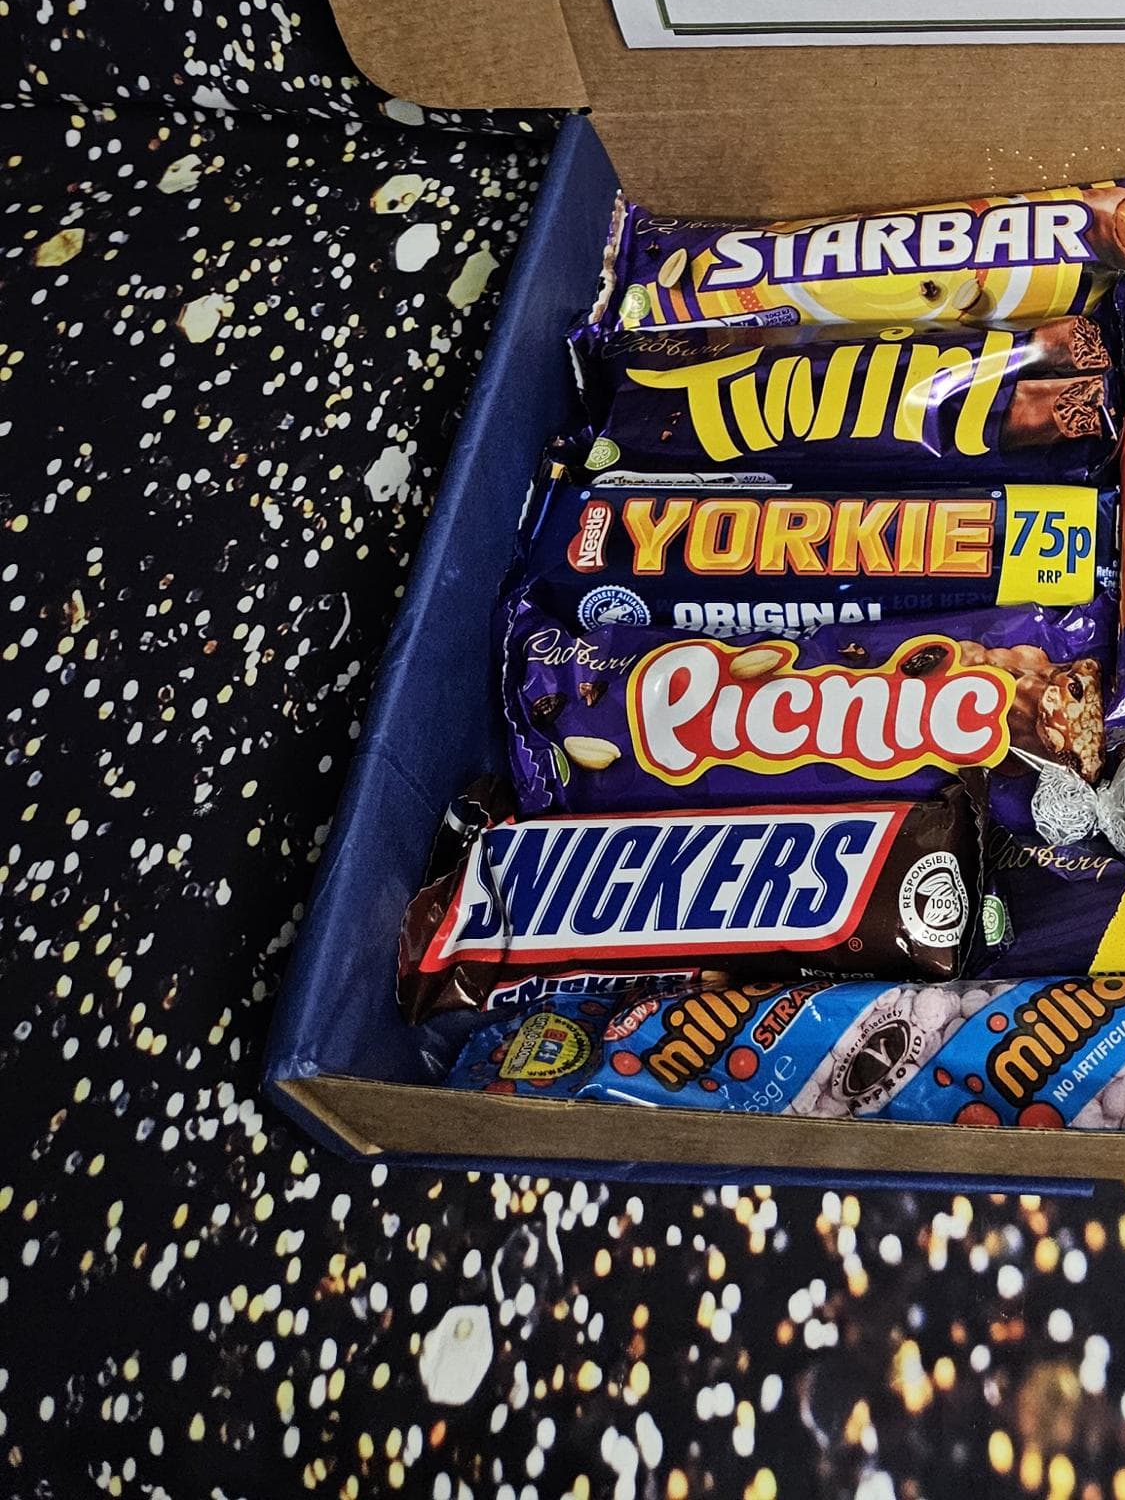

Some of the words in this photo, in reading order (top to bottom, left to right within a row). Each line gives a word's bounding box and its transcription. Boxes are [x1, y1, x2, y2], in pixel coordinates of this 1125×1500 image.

[706, 202, 1093, 286] STARBAR
[627, 326, 1014, 463] Twirl
[623, 497, 998, 576] YORKIE
[1009, 510, 1092, 573] 75p
[584, 590, 617, 618] RAINFOREST
[618, 591, 645, 619] ALLIANCE
[1037, 569, 1063, 585] RRP
[524, 628, 636, 675] Cadbury
[640, 642, 1001, 773] Picnic
[456, 819, 879, 941] SNICKERS
[902, 854, 955, 910] RESPONSIBLY
[800, 966, 835, 979] NOT
[833, 1026, 869, 1087] Vegetarian
[849, 1031, 922, 1111] APPROVED
[1053, 1079, 1075, 1103] NO
